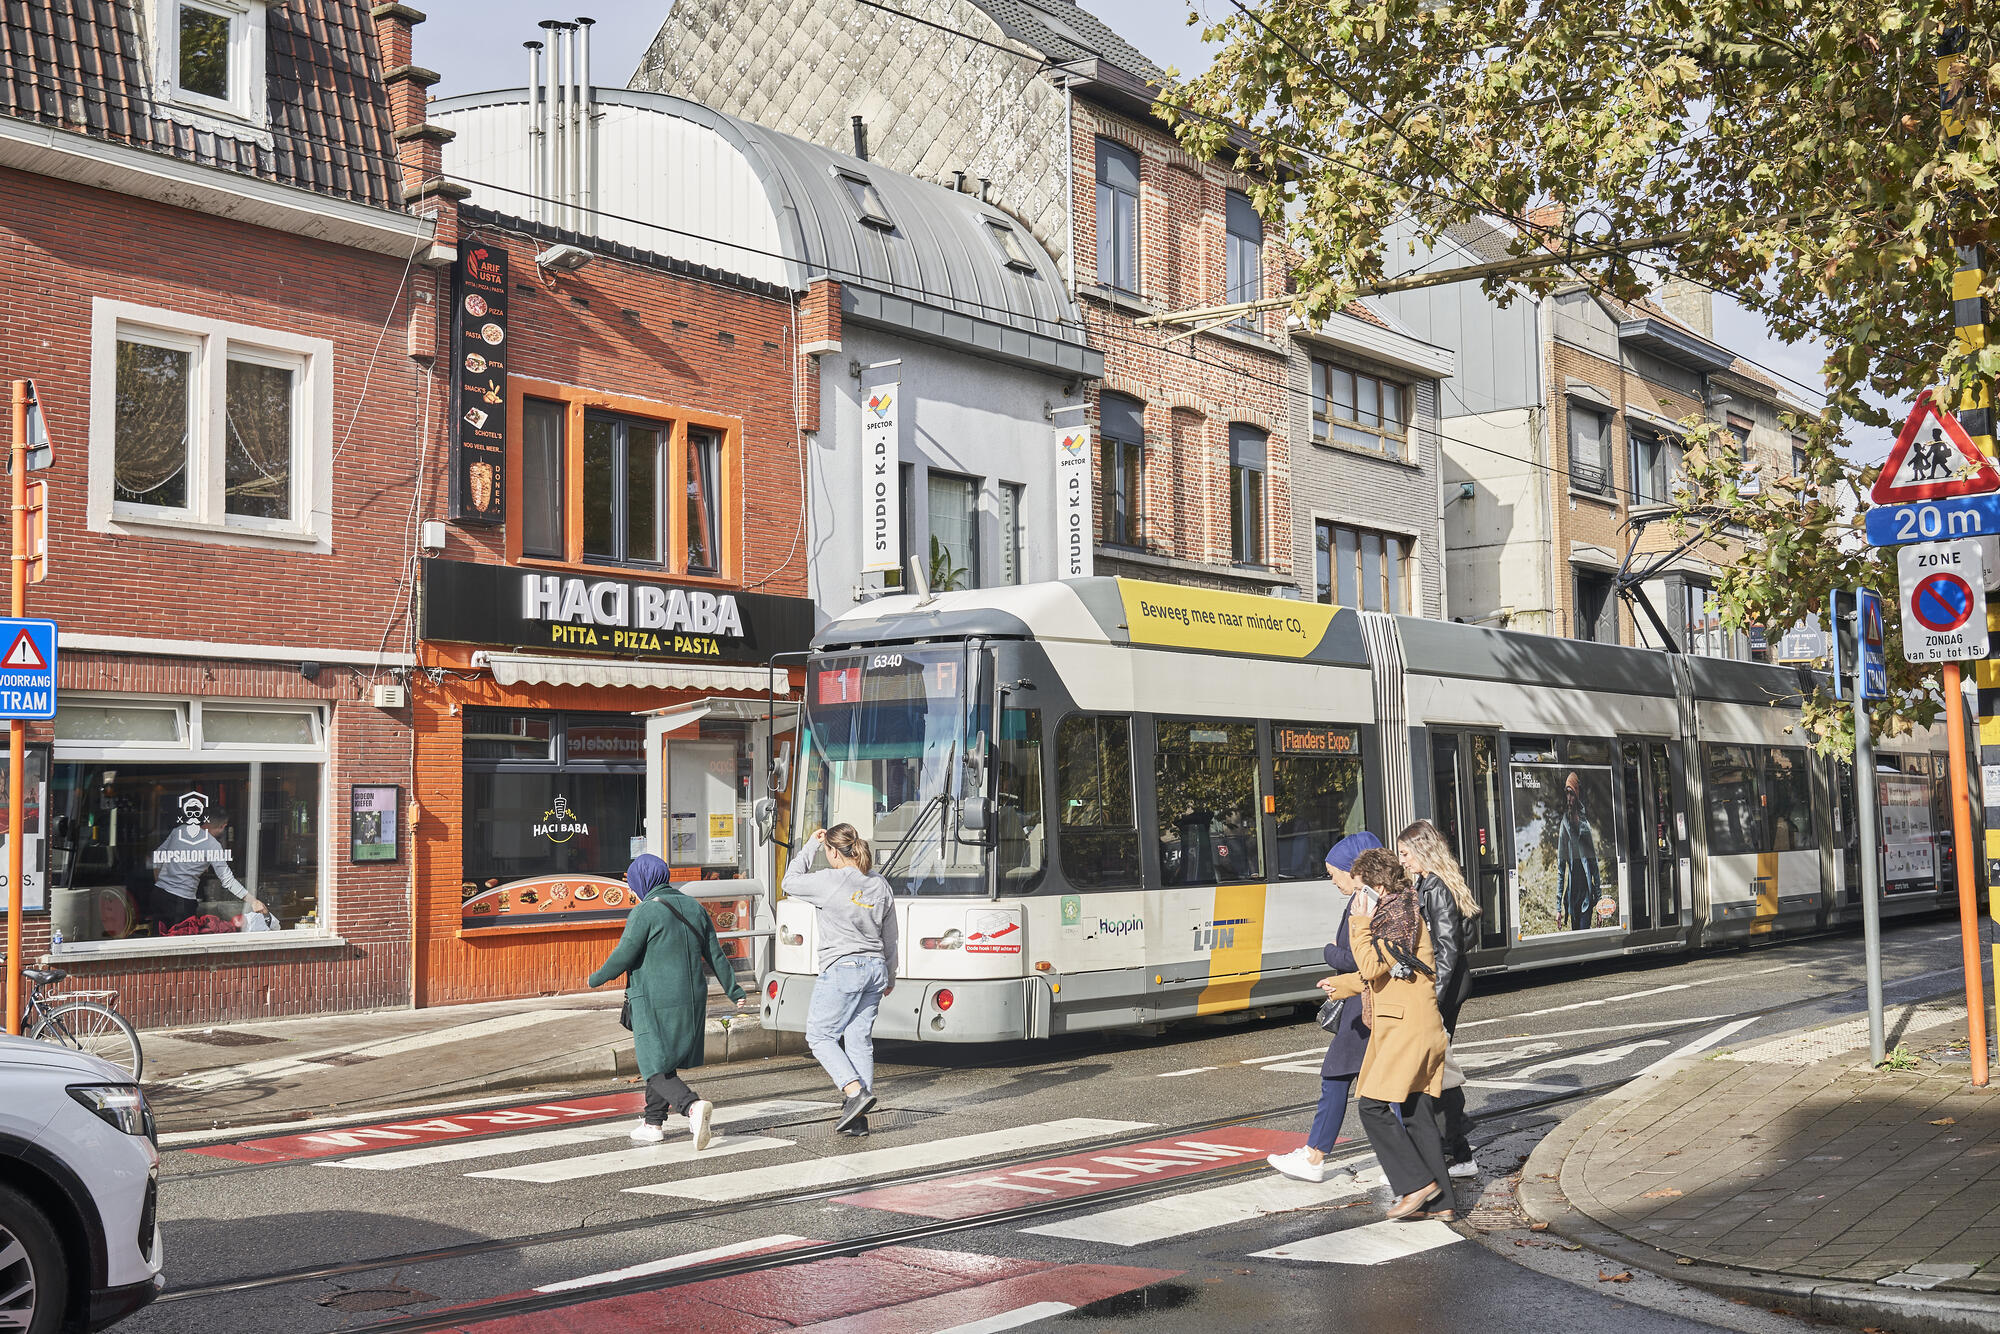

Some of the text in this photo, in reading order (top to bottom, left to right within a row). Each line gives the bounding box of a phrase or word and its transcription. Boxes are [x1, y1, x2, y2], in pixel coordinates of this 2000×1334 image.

[481, 262, 500, 272] ARIF
[479, 272, 502, 284] USTA
[488, 307, 504, 316] PIZZA
[465, 331, 482, 339] PASTA
[488, 361, 504, 369] PITTA
[464, 384, 486, 394] SNACK'S
[867, 420, 893, 430] SPECTOR
[474, 429, 503, 440] SCHOTEL'S
[1061, 458, 1086, 467] SPECTOR
[875, 435, 887, 551] STUDIO K.D.
[1069, 472, 1081, 575] STUDIO K.D.
[1894, 506, 1981, 541] 20 m
[1918, 552, 1961, 567] ZONE
[522, 574, 745, 638] HACI BABA
[1140, 600, 1190, 626] Beweeg
[1191, 609, 1216, 624] mee
[1217, 612, 1243, 628] naar
[1246, 613, 1283, 632] minder
[552, 625, 598, 646] PITTA
[614, 630, 661, 651] PIZZA
[674, 636, 720, 656] PASTA
[1925, 633, 1963, 647] ZONDAG
[1906, 645, 1985, 660] van 5u tot 15u
[873, 654, 902, 668] 6340
[837, 670, 847, 701] 1
[1867, 669, 1884, 691] TRAM
[1, 691, 47, 710] TRAM
[1286, 730, 1325, 750] Flanders
[1327, 731, 1350, 753] Expo
[354, 792, 375, 800] GIDEON
[533, 823, 589, 837] HACI BABA
[153, 848, 233, 864] KAPSALON HALIL
[1099, 913, 1144, 937] Hoppin
[1193, 928, 1235, 952] LIJN
[299, 1104, 620, 1148] TRAM
[948, 1140, 1266, 1195] TRAM
